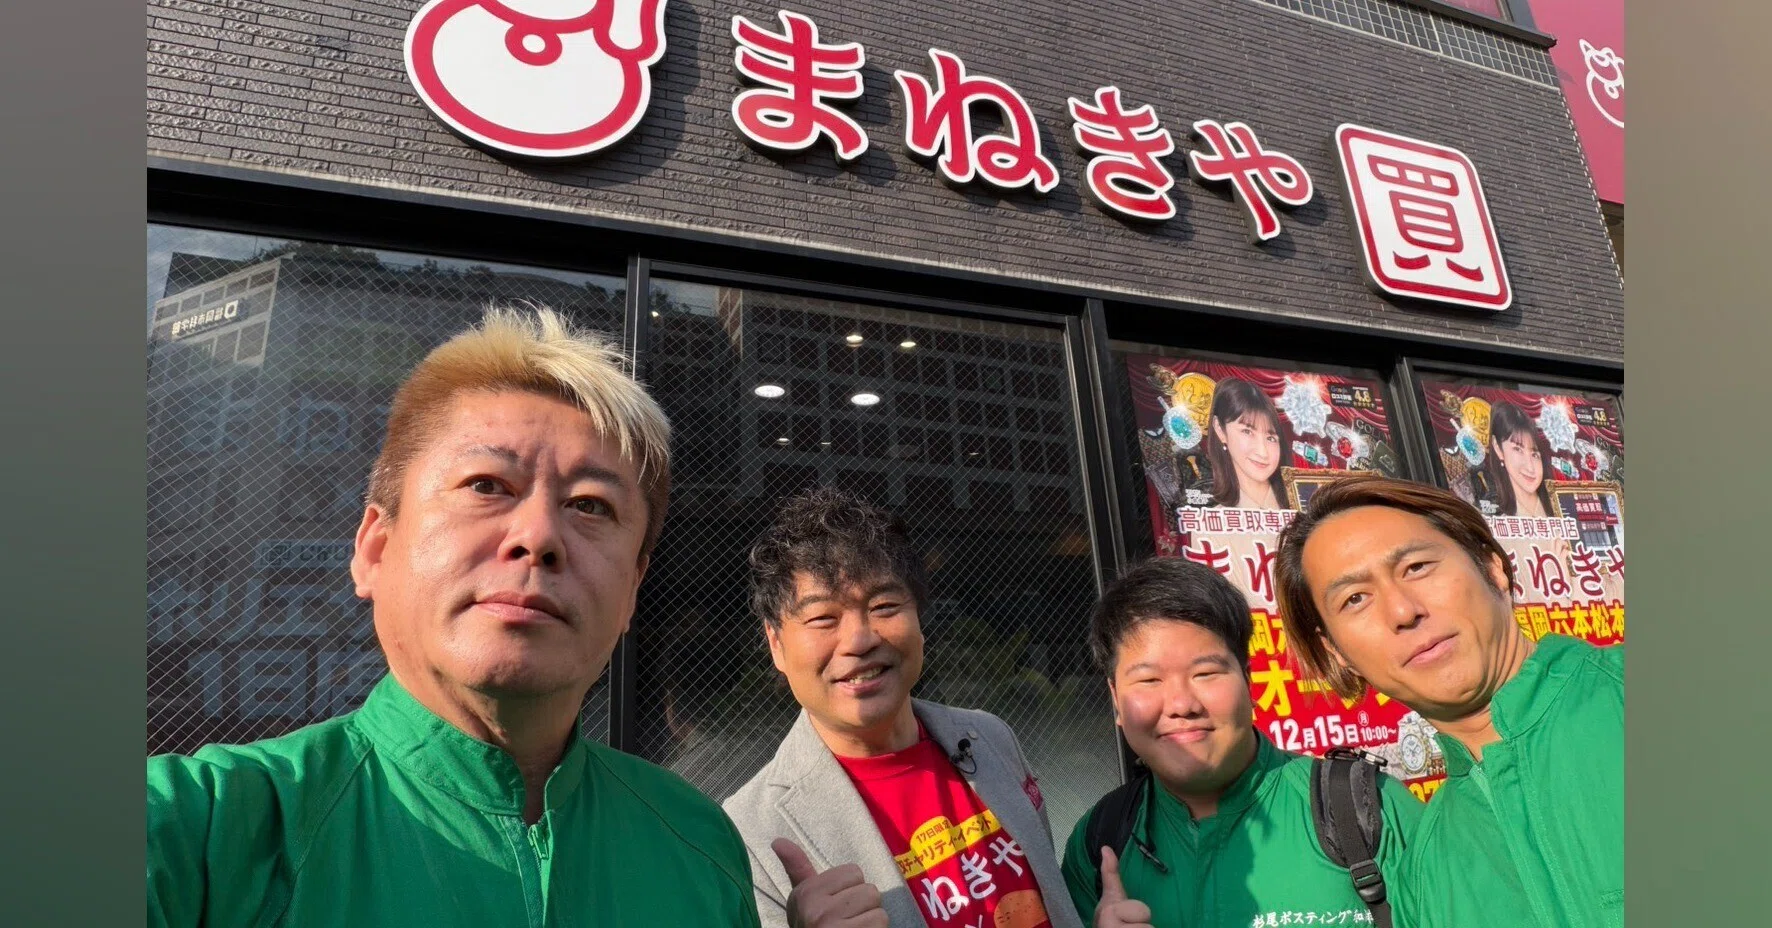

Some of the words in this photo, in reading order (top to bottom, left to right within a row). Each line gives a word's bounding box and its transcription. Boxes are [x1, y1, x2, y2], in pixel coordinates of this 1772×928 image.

[731, 9, 1314, 241] まねきや
[1365, 152, 1484, 284] 買
[1354, 389, 1372, 403] 4.8
[1269, 715, 1360, 751] 12月15日
